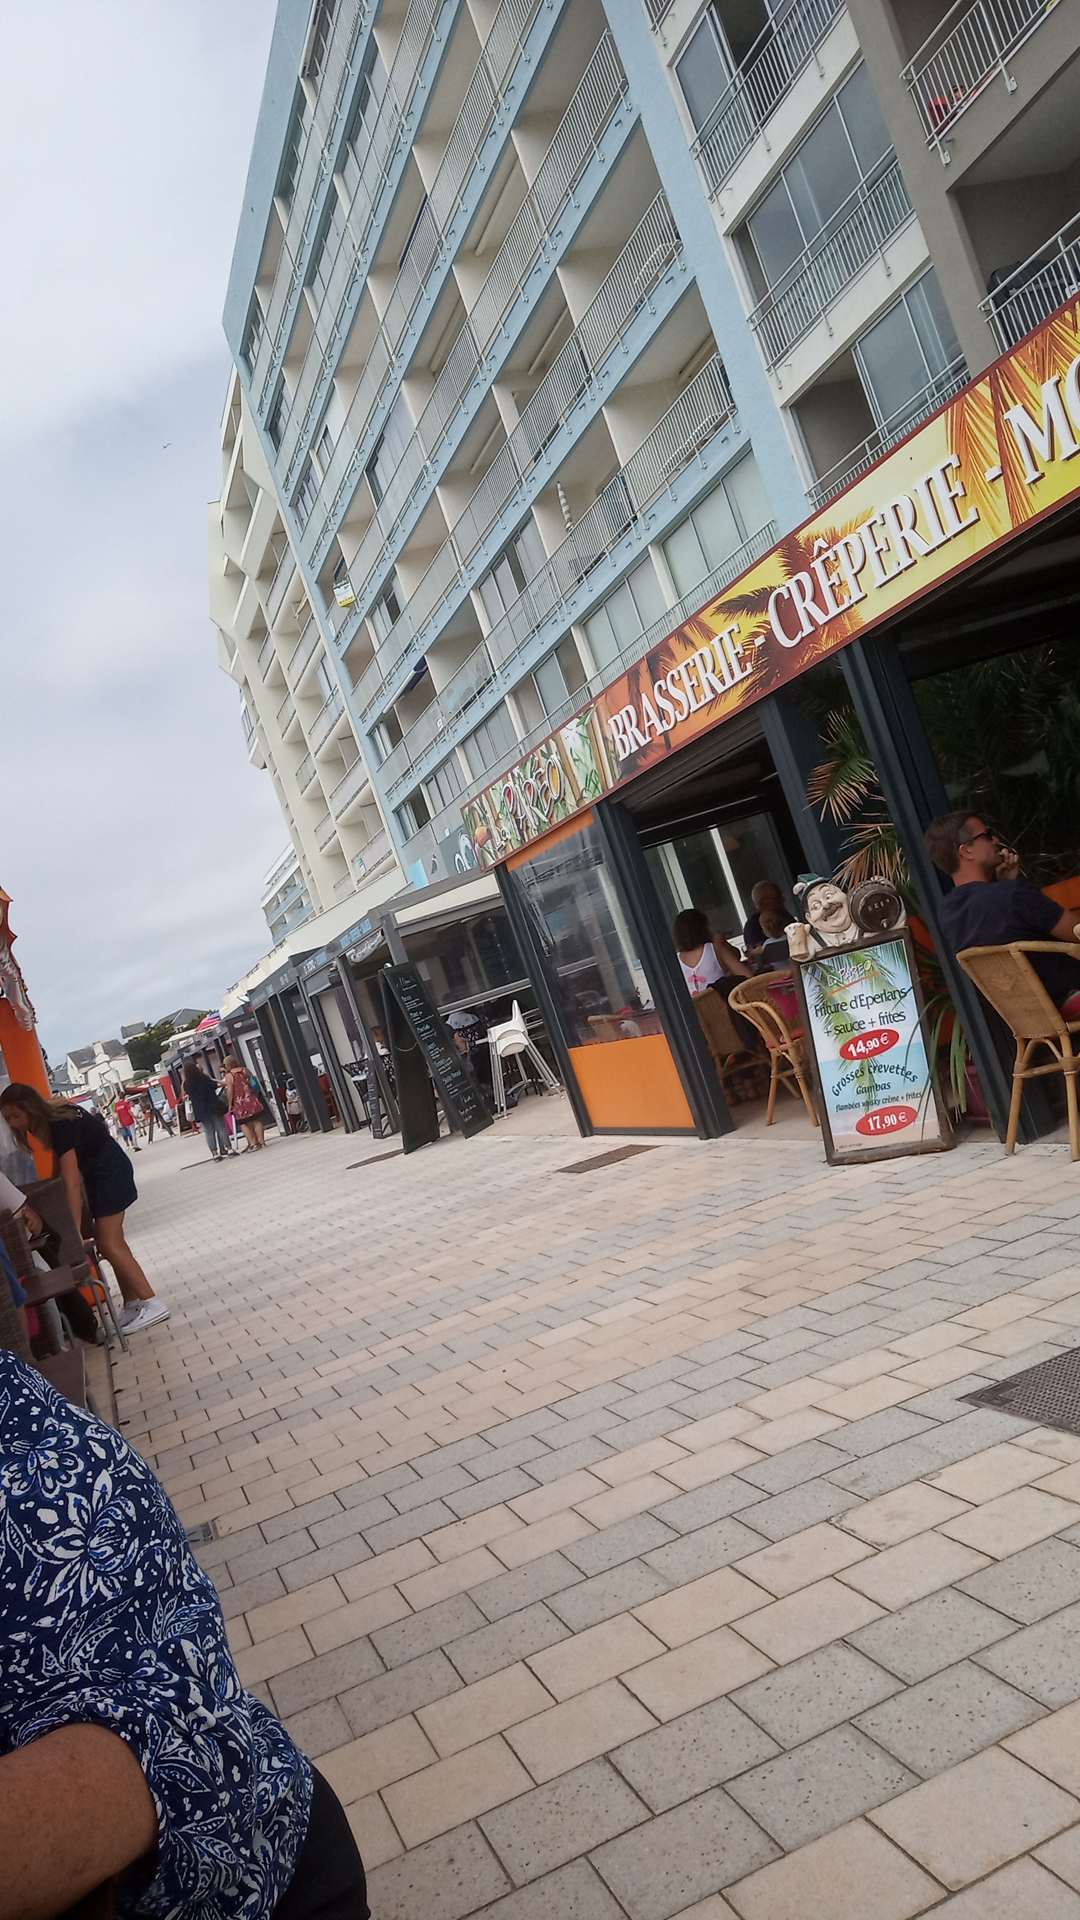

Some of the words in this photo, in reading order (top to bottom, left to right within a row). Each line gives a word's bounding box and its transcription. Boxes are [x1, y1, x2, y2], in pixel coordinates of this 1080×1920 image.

[607, 622, 754, 762] BRASSERIE
[767, 453, 980, 648] CRÊPERIE
[814, 1001, 848, 1018] Friture
[849, 987, 907, 1009] d'Eperlans
[833, 1020, 866, 1036] sauce
[878, 1010, 907, 1026] frites
[831, 1065, 865, 1097] Grosses
[867, 1063, 918, 1083] crevettes
[855, 1081, 892, 1096] Gambas
[835, 1101, 861, 1113] flambées
[881, 1095, 900, 1104] crème
[905, 1091, 922, 1102] frites
